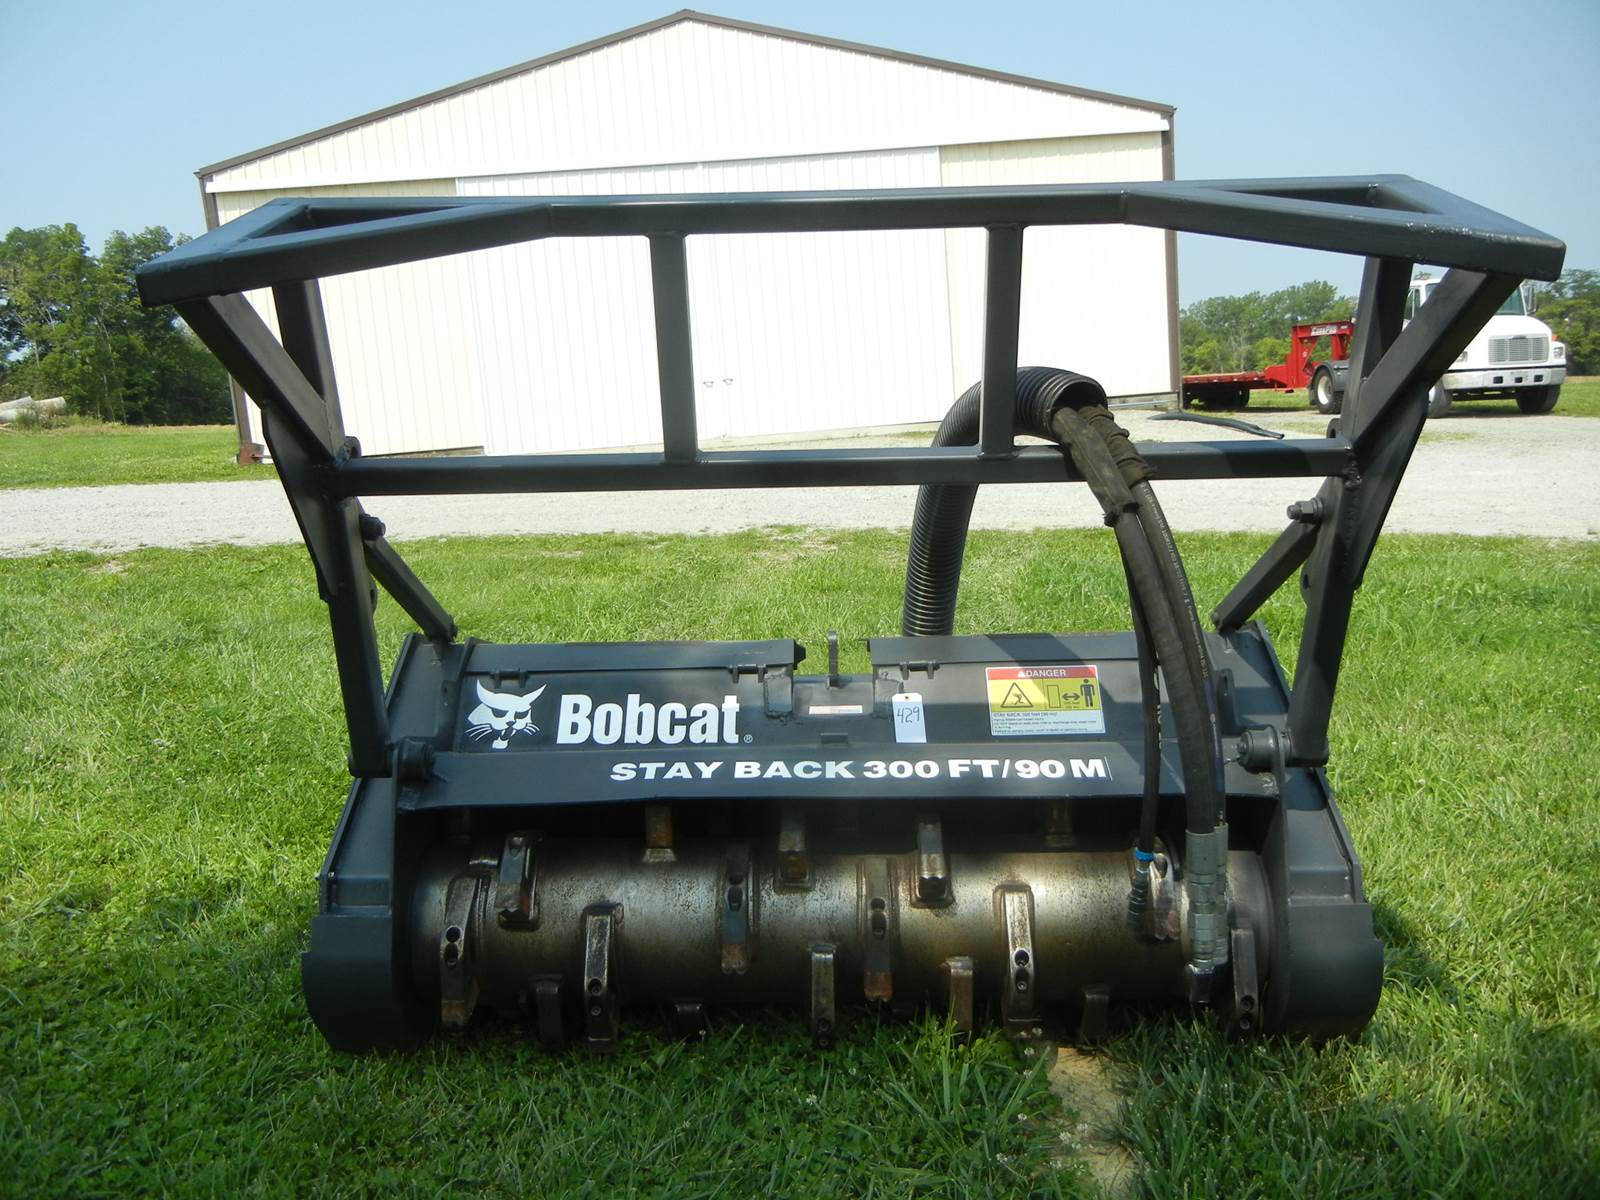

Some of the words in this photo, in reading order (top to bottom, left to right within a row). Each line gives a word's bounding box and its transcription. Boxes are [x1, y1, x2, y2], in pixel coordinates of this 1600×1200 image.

[1025, 669, 1067, 678] DANGER
[556, 693, 741, 745] Bobcat
[897, 706, 920, 724] 429
[610, 761, 724, 781] STAY
[734, 760, 856, 779] BACK
[863, 759, 940, 779] 300
